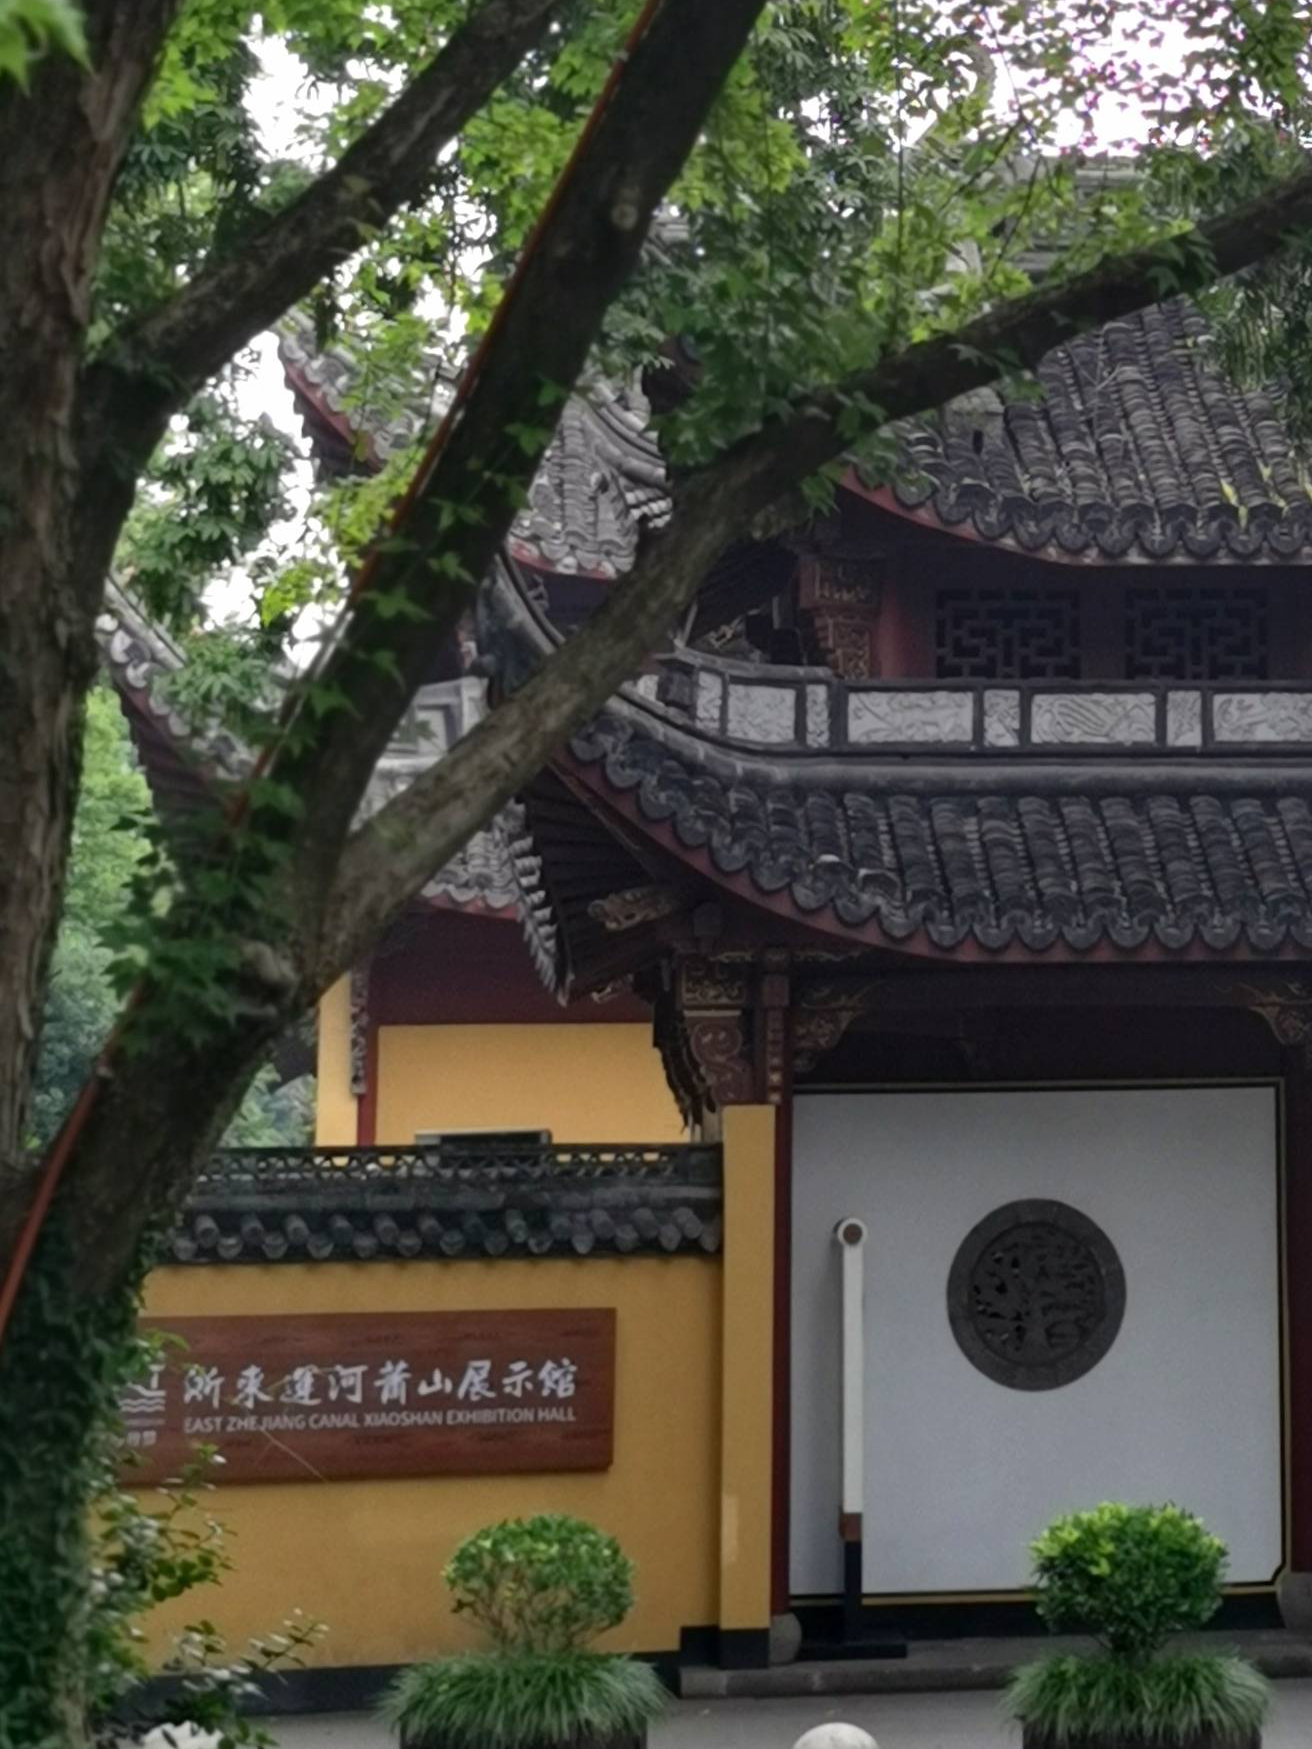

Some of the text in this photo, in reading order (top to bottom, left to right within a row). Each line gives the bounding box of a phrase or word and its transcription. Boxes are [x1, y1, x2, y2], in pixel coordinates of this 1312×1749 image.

[184, 1416, 223, 1434] EAST
[226, 1413, 306, 1432] ZHEJIANG
[308, 1412, 361, 1429] CANAL
[364, 1409, 443, 1427] XIAOSHAN
[446, 1407, 535, 1425] EXHIBITION
[537, 1405, 577, 1422] HALL
